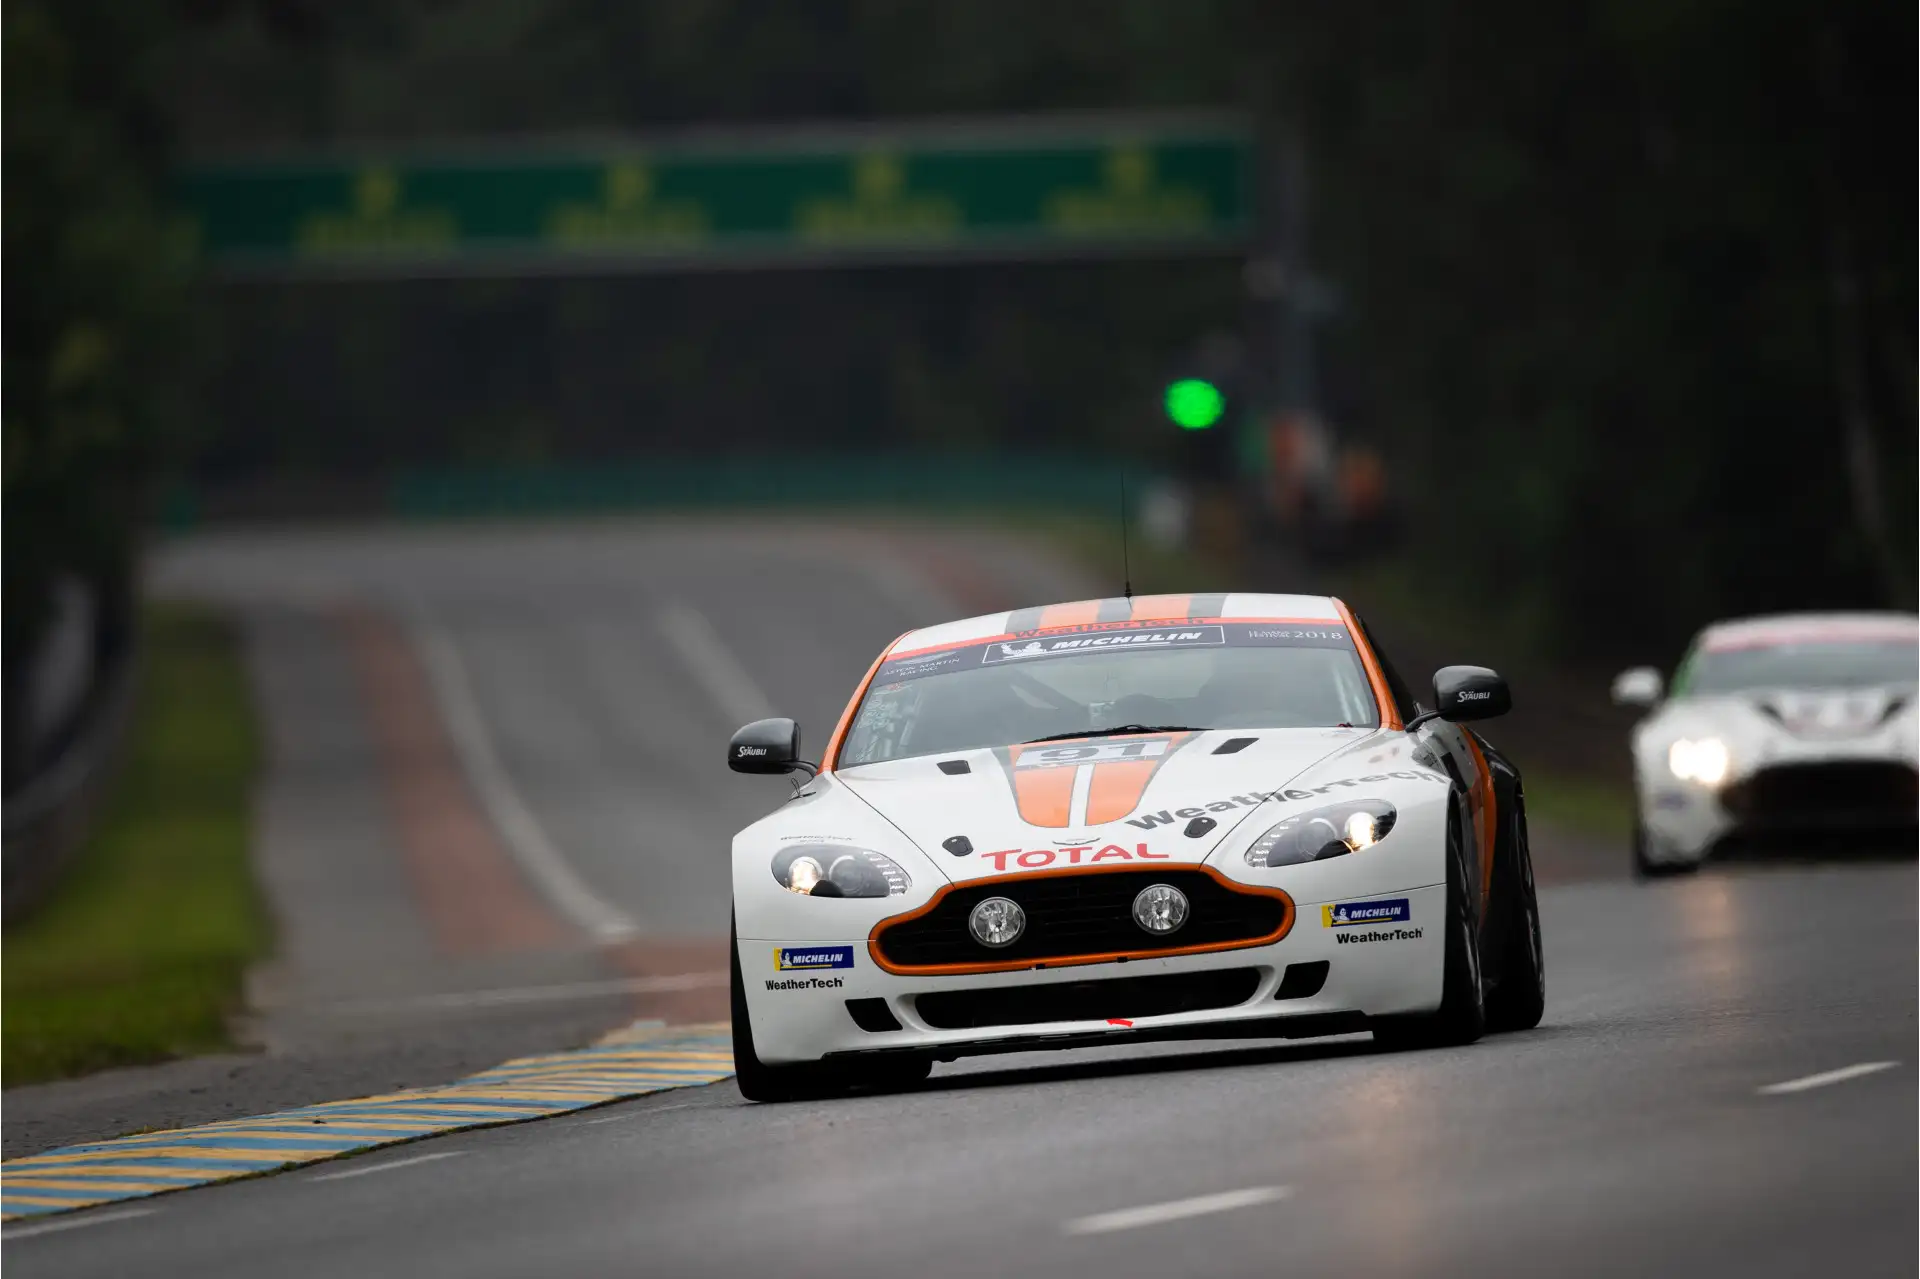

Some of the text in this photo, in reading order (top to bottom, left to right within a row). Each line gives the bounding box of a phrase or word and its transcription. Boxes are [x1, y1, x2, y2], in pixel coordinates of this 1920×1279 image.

[1051, 632, 1202, 650] MICHELIN
[1294, 630, 1343, 639] 2018
[1457, 691, 1490, 703] STÄUBLI
[737, 746, 767, 757] STÄUBLI
[1039, 743, 1148, 762] 91
[1126, 769, 1447, 832] WeatherTech
[981, 843, 1170, 871] TOTAL
[1351, 907, 1402, 919] MICHELIN
[1336, 928, 1423, 944] WeatherTech
[793, 953, 843, 964] MICHELIN
[765, 978, 844, 991] WeatherTech
